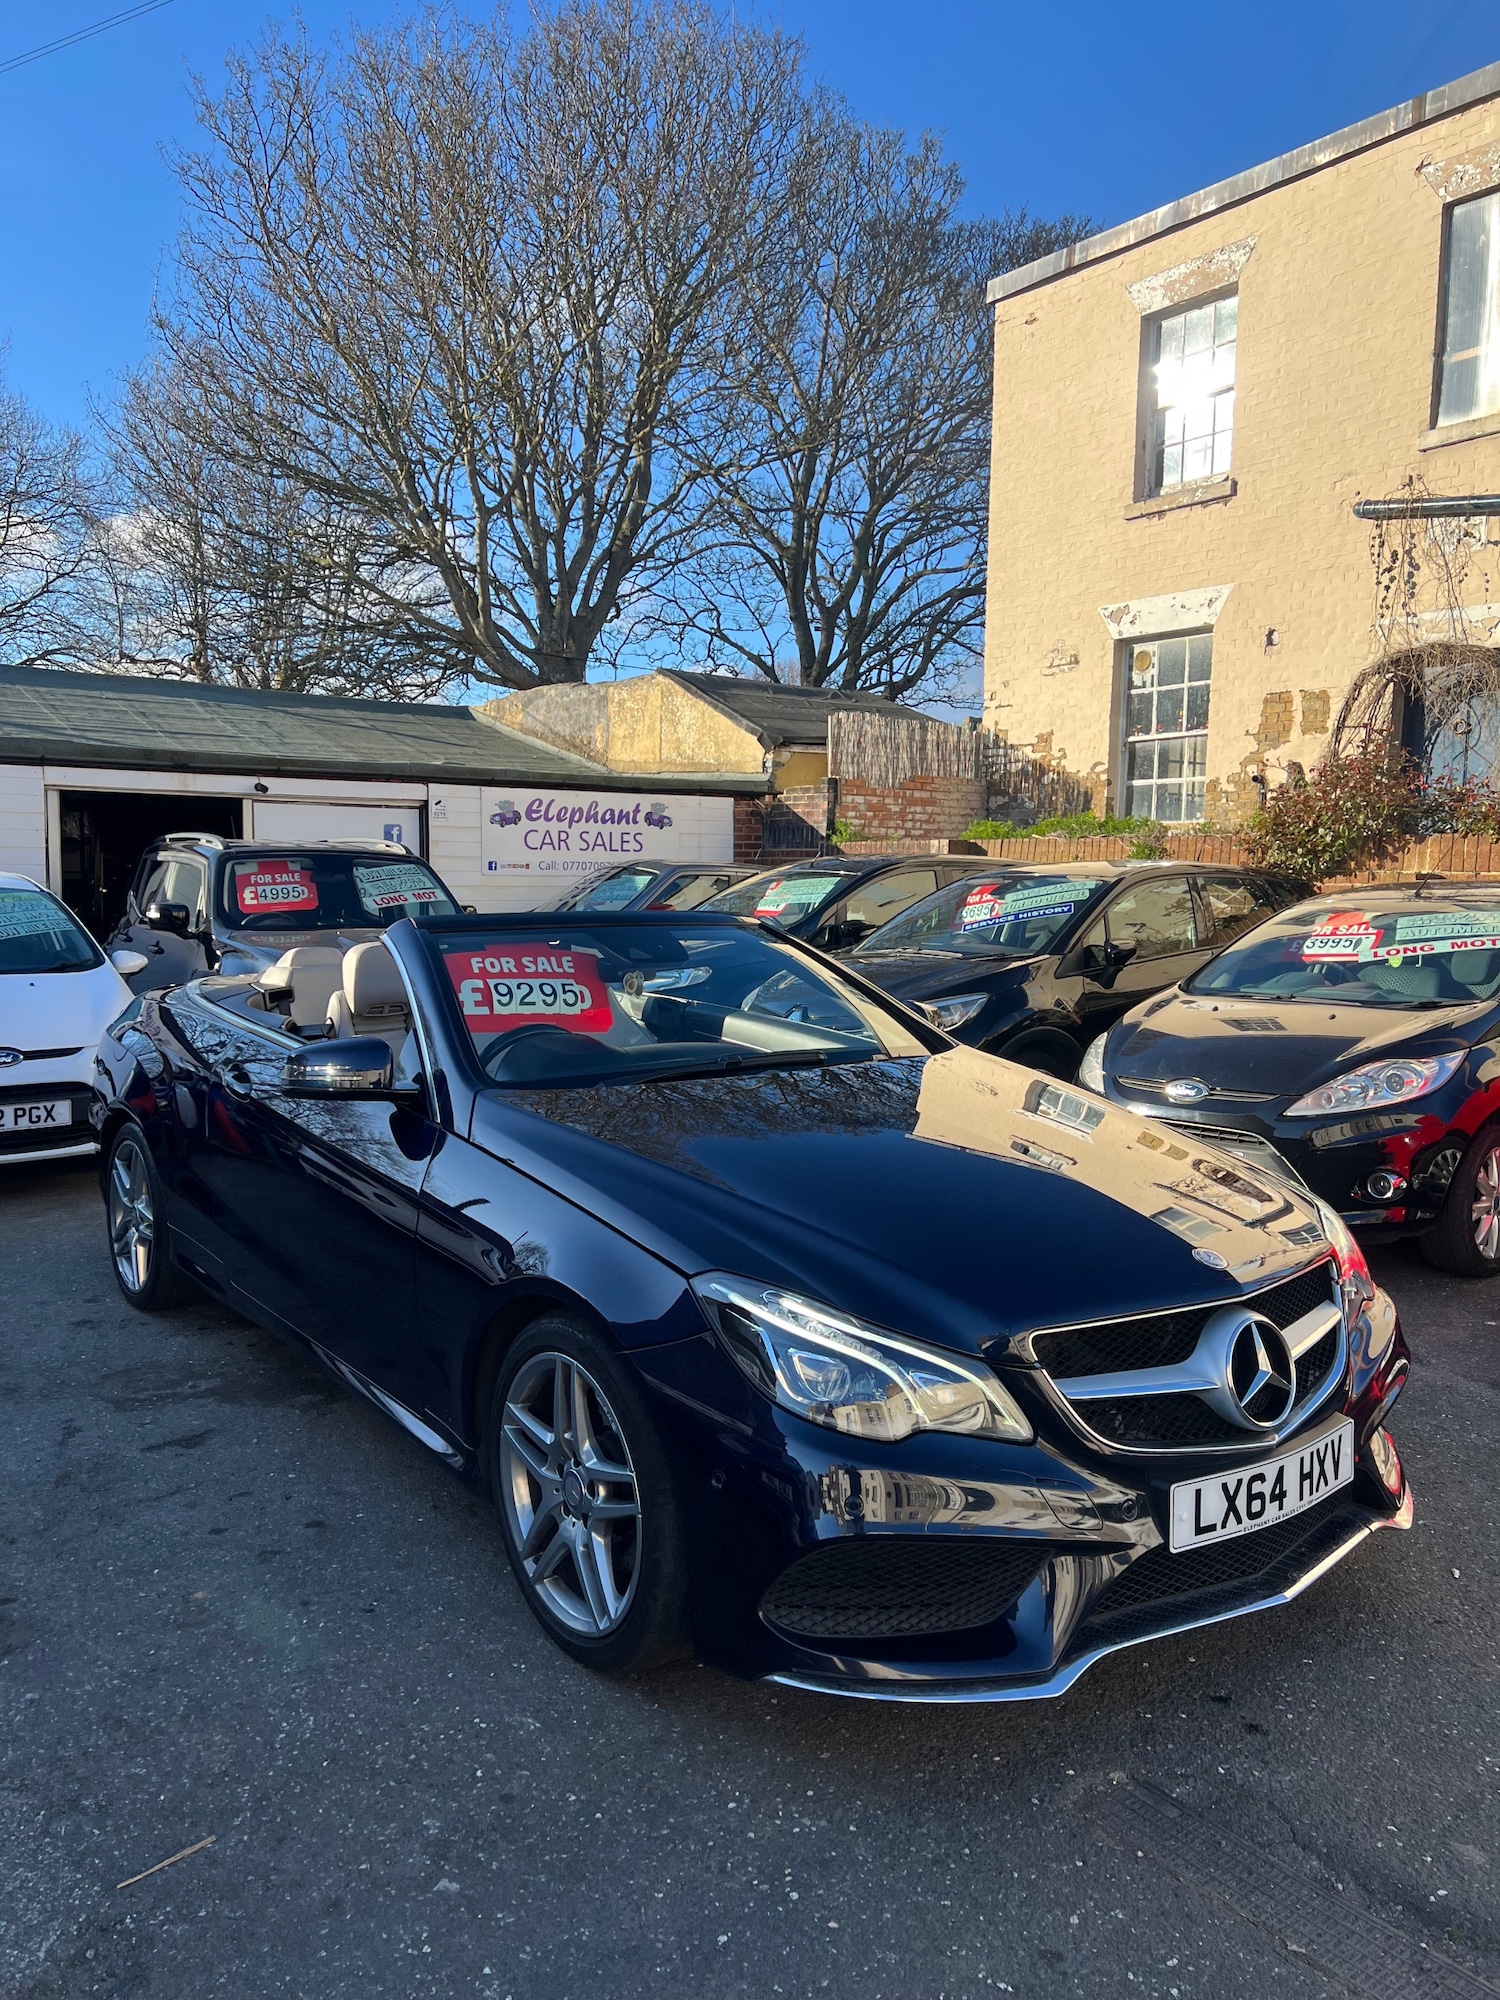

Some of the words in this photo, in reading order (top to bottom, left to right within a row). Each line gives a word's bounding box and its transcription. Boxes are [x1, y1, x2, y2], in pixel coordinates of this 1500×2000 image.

[525, 798, 641, 829] Elephant
[524, 829, 570, 851] CAR
[579, 831, 644, 852] SALES
[538, 860, 559, 870] Call:
[250, 874, 272, 884] FOR
[274, 873, 301, 882] SALE
[372, 894, 408, 906] LONG
[412, 891, 438, 901] MOT
[965, 915, 1015, 931] SERVICE
[1019, 906, 1071, 919] HISTORY
[1372, 944, 1435, 959] LONG
[1451, 938, 1500, 950] MOT
[470, 957, 518, 973] FOR
[521, 956, 575, 973] SALE
[458, 979, 580, 1015] £9295
[14, 1104, 56, 1126] PGX
[1194, 1465, 1287, 1537] LX64
[1299, 1434, 1343, 1502] HXV
[1243, 1519, 1270, 1532] ELEPHANT
[1282, 1509, 1296, 1518] SALES
